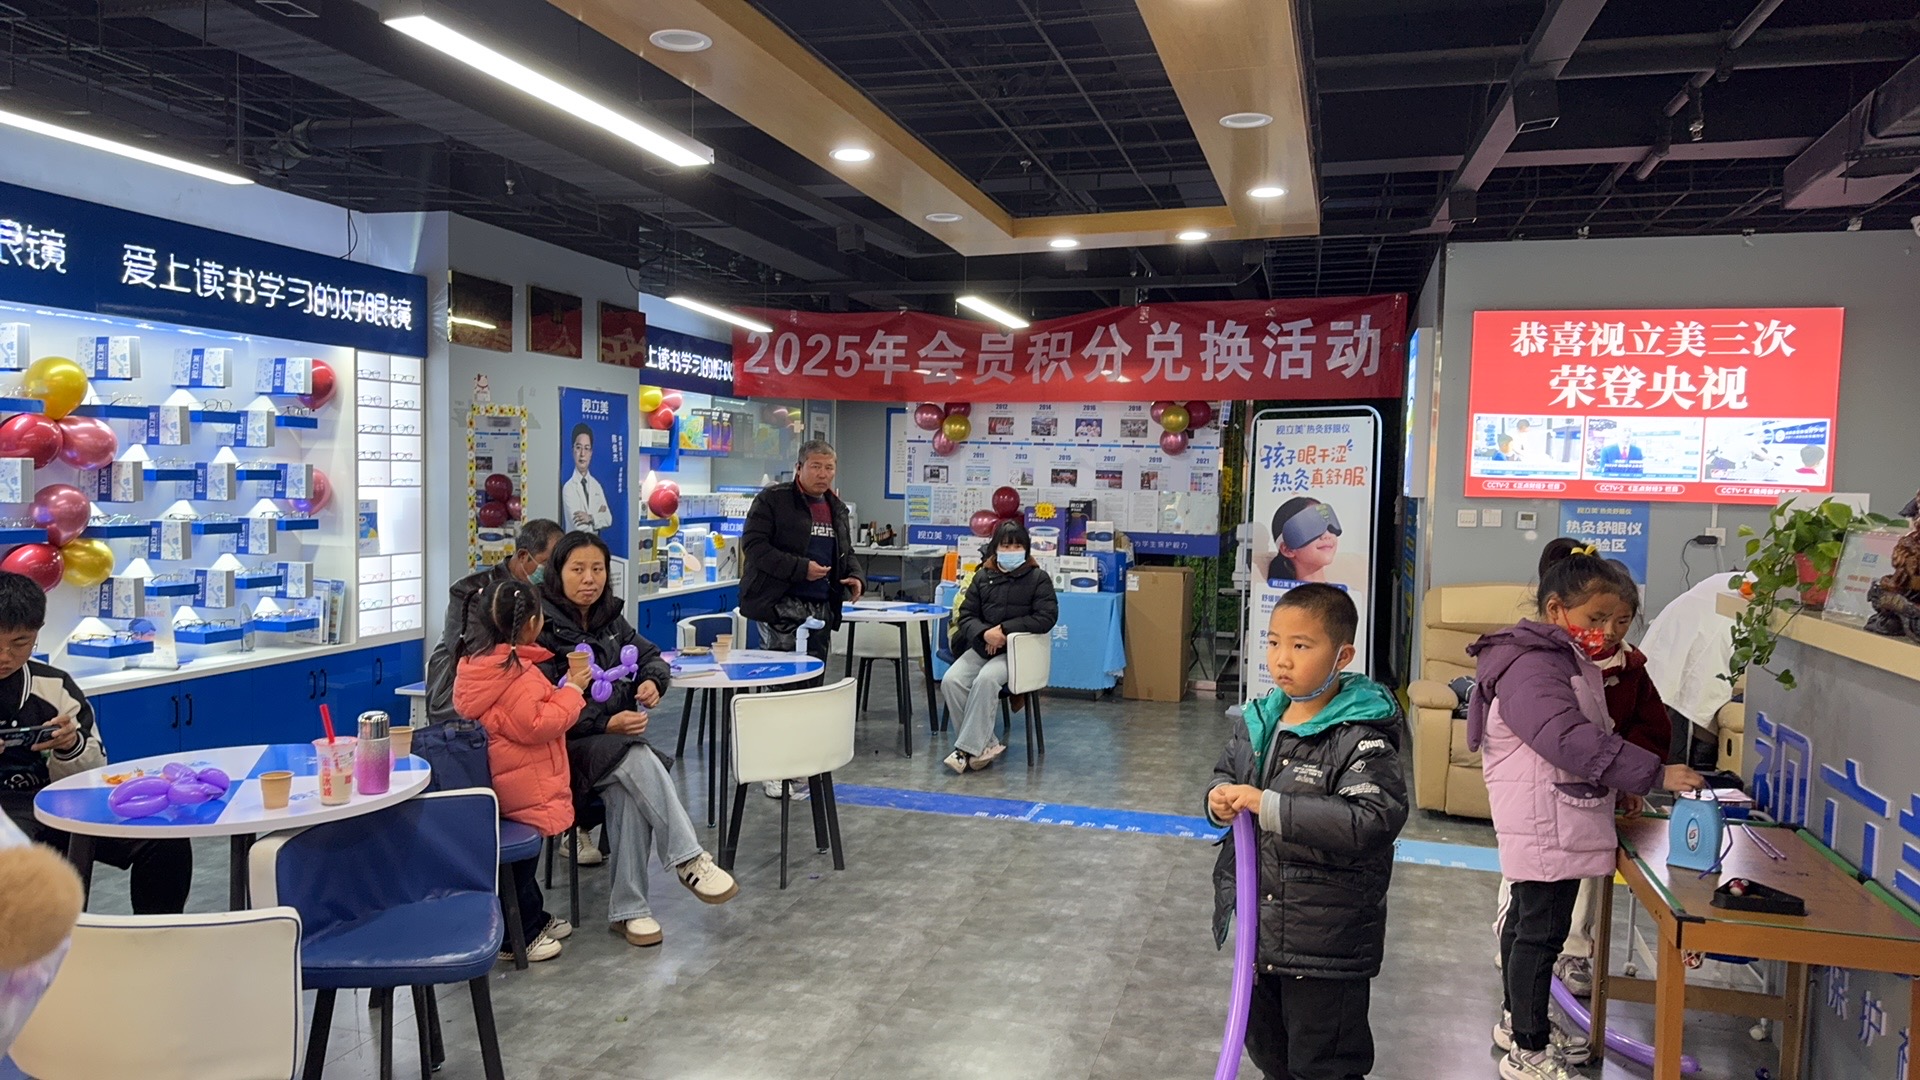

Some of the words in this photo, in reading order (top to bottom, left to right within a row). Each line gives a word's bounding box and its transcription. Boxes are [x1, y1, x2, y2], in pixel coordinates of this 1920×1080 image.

[121, 243, 413, 332] 爱上读书学习的好眼镜
[743, 313, 1382, 386] 2025年会员积分兑换活动
[1510, 319, 1797, 358] 恭喜视立美三次
[1548, 363, 1749, 411] 荣登央视
[581, 398, 609, 415] 视立美
[1271, 467, 1366, 493] 热灸真舒服
[1565, 519, 1643, 536] 热灸舒眼仪
[1134, 540, 1189, 550] 为学生保护视力
